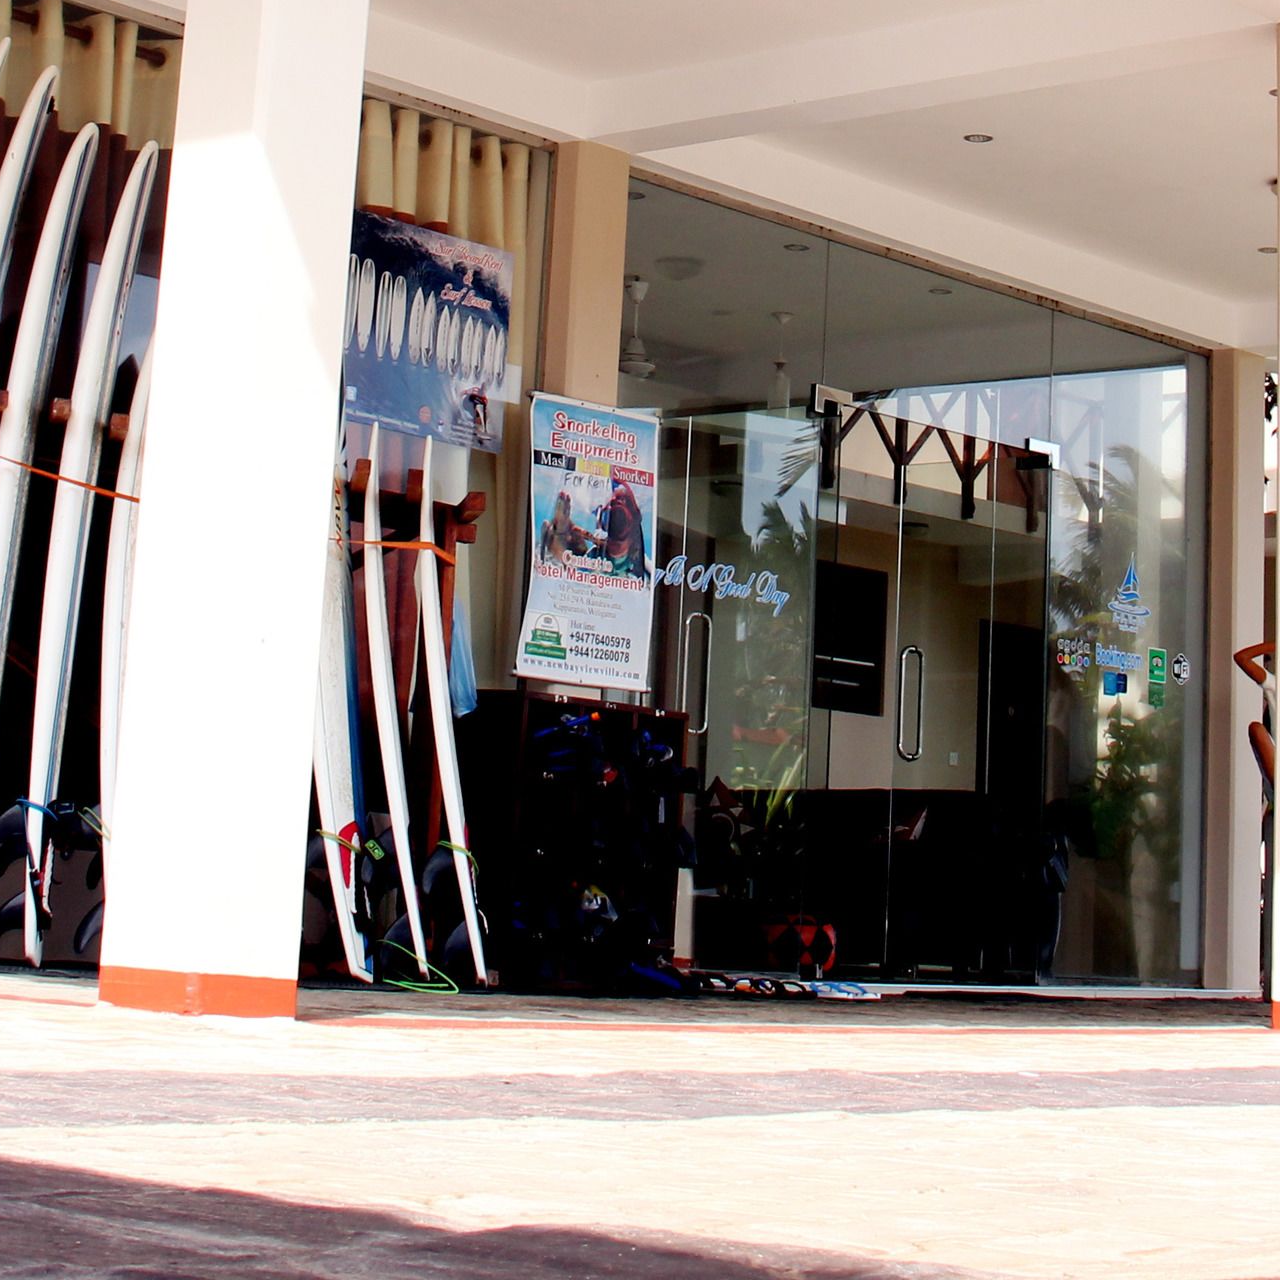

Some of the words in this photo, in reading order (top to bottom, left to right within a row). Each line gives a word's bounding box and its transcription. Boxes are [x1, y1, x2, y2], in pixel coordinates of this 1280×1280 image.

[554, 411, 636, 448] Snorkeling
[614, 465, 649, 485] Snorkel
[567, 567, 643, 591] Management
[713, 564, 756, 599] Good
[756, 570, 790, 617] Day
[523, 658, 640, 680] www.newbayviewvilla.com
